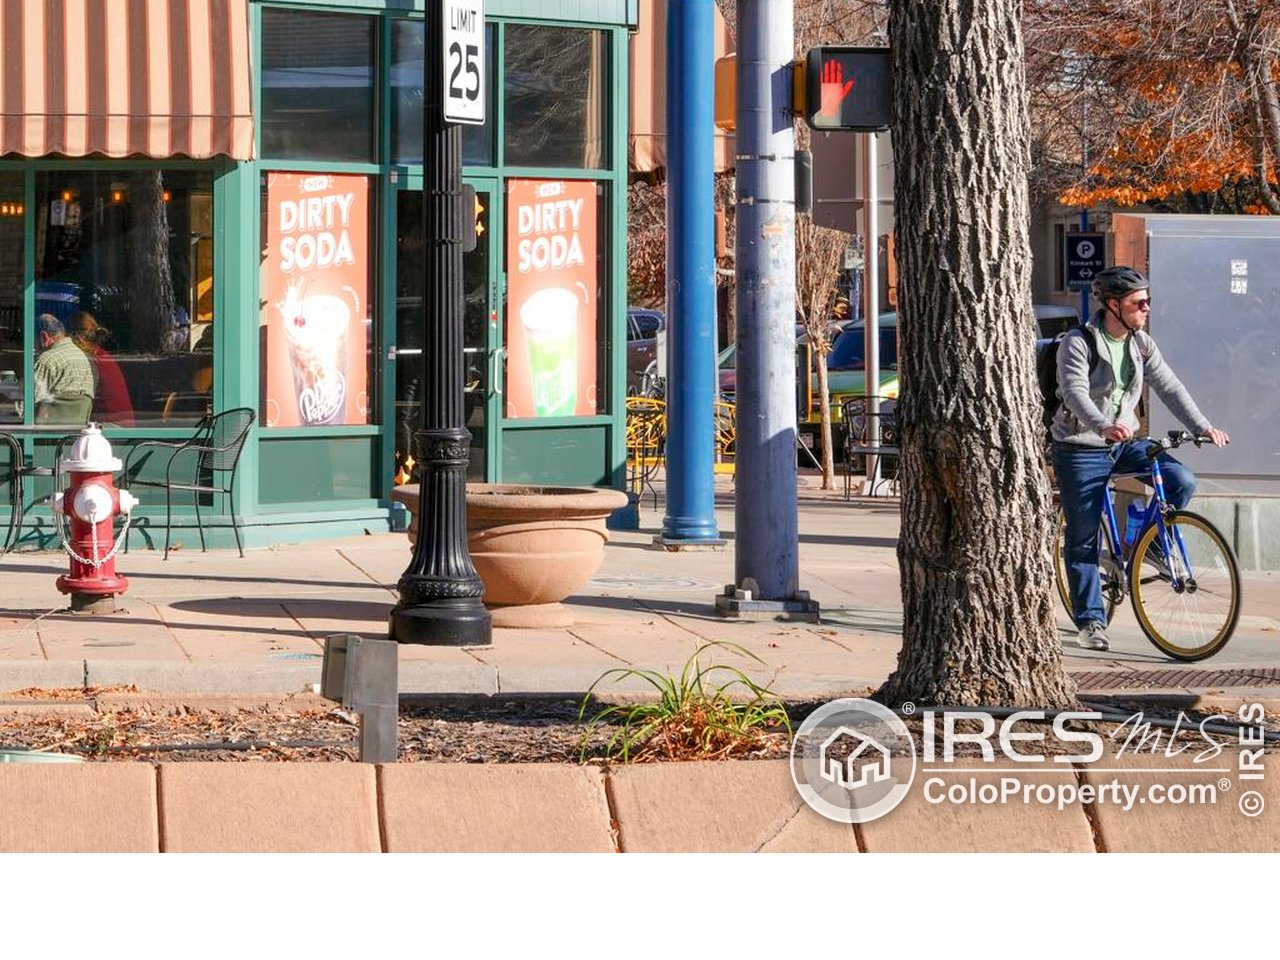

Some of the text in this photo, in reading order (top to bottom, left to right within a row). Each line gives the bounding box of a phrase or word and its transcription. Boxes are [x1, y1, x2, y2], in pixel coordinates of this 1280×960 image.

[451, 7, 477, 34] LIMIT
[449, 41, 480, 102] 25
[280, 193, 353, 233] DIRTY
[518, 198, 583, 236] DIRTY
[280, 230, 356, 273] SODA
[518, 232, 585, 272] SODA
